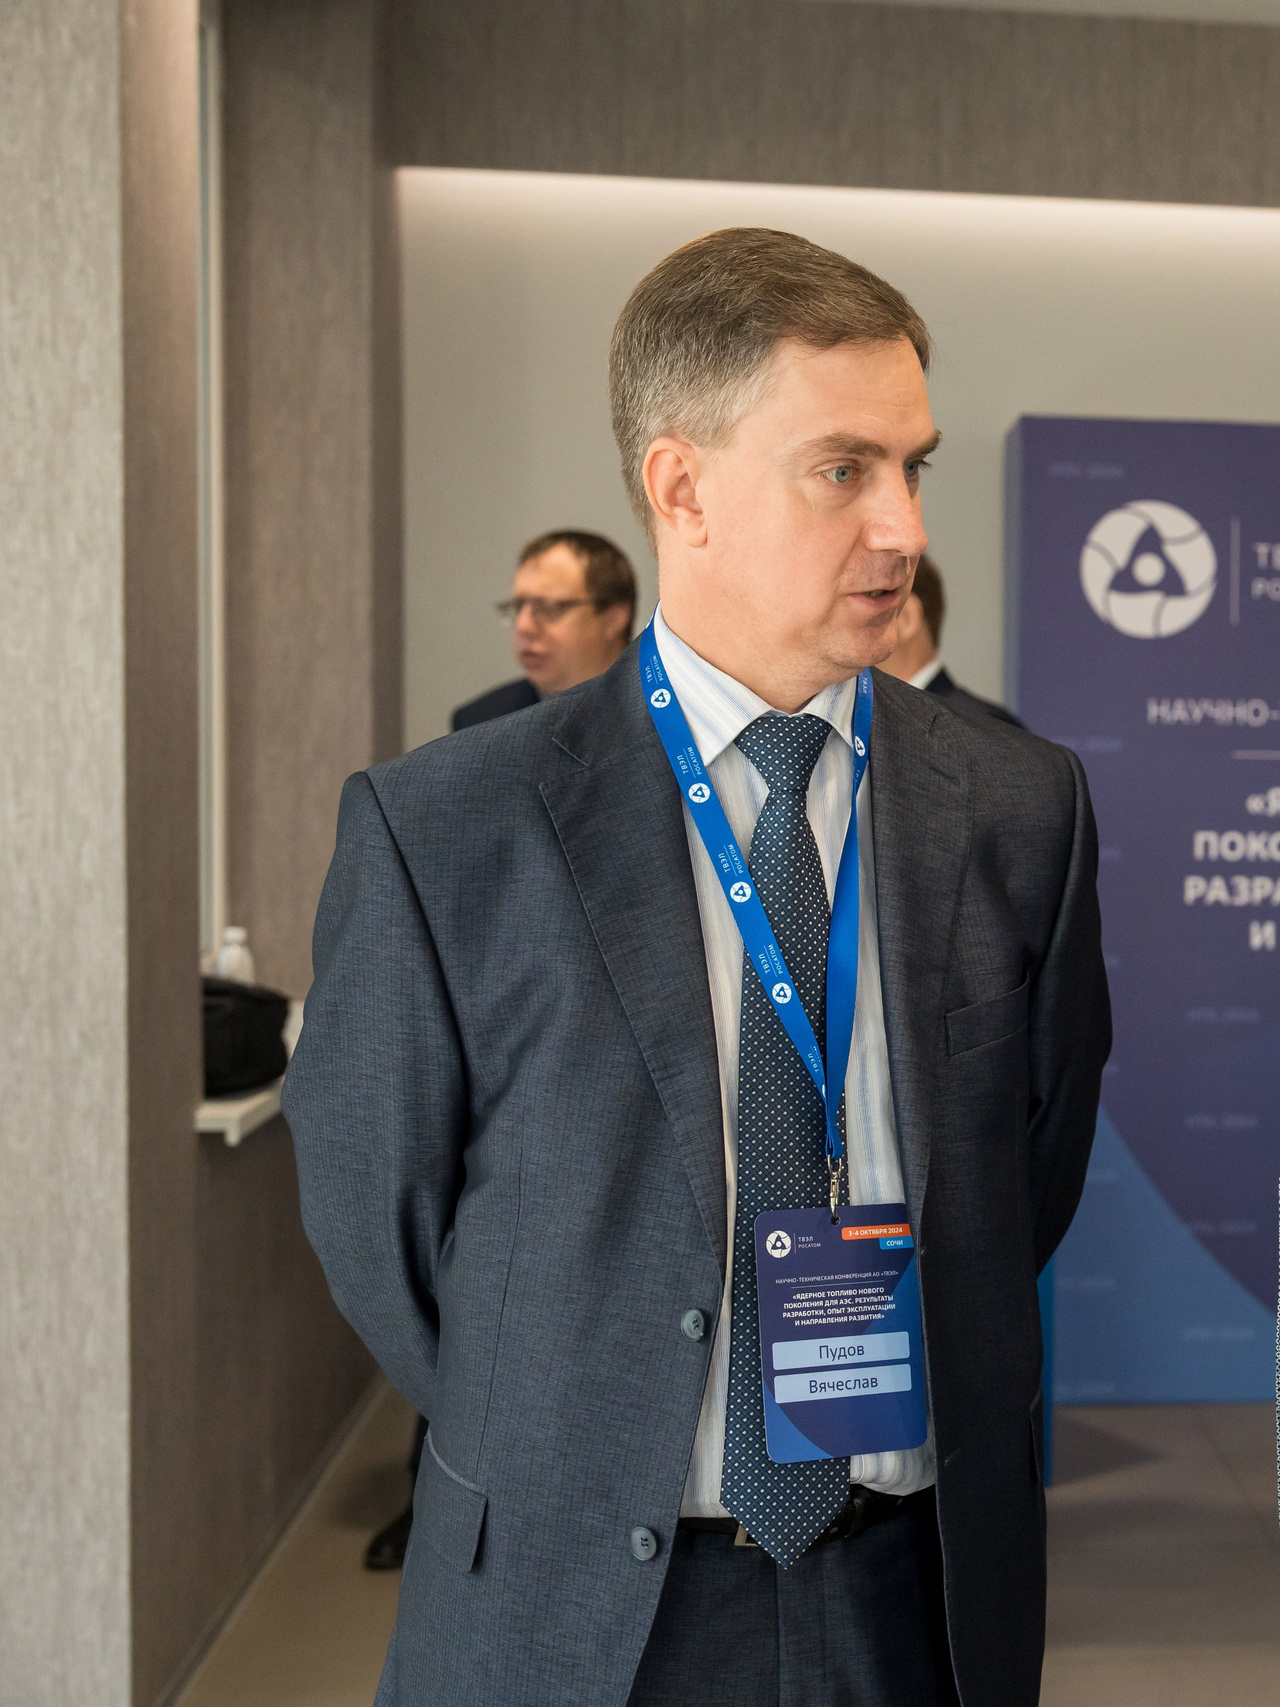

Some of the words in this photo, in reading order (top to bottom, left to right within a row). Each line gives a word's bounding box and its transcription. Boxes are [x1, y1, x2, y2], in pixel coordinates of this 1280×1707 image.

[677, 754, 689, 775] ТВЭЛ
[687, 746, 702, 776] РОСАТОМ
[718, 853, 731, 873] ТВЭЛ
[728, 843, 744, 874] РОСАТОМ
[1250, 921, 1276, 950] И
[758, 953, 771, 974] ТВЭЛ
[768, 944, 784, 975] РОСАТОМ
[859, 1228, 887, 1236] ОКТЯБРЯ
[886, 1239, 904, 1247] СОЧИ
[775, 1273, 834, 1284] НАУЧНО-ТЕХНИЧЕСКАЯ
[834, 1271, 872, 1280] КОНФЕРЕНЦИЯ
[792, 1291, 826, 1300] «ЯДЕРНОЕ
[826, 1289, 858, 1297] ТОПЛИВО
[858, 1287, 885, 1295] НОВОГО
[782, 1309, 826, 1319] РАЗРАБОТКИ,
[826, 1307, 846, 1315] ОПЫТ
[846, 1303, 896, 1314] ЭКСПЛУАТАЦИИ
[783, 1300, 823, 1310] ПОКОЛЕНИЯ
[824, 1299, 839, 1307] ДЛЯ
[855, 1295, 894, 1304] РЕЗУЛЬТАТЫ
[801, 1316, 848, 1326] НАПРАВЛЕНИЯ
[848, 1313, 885, 1322] РАЗВИТИЯ»
[819, 1345, 865, 1361] Пудов
[809, 1376, 878, 1394] Вячеслав
